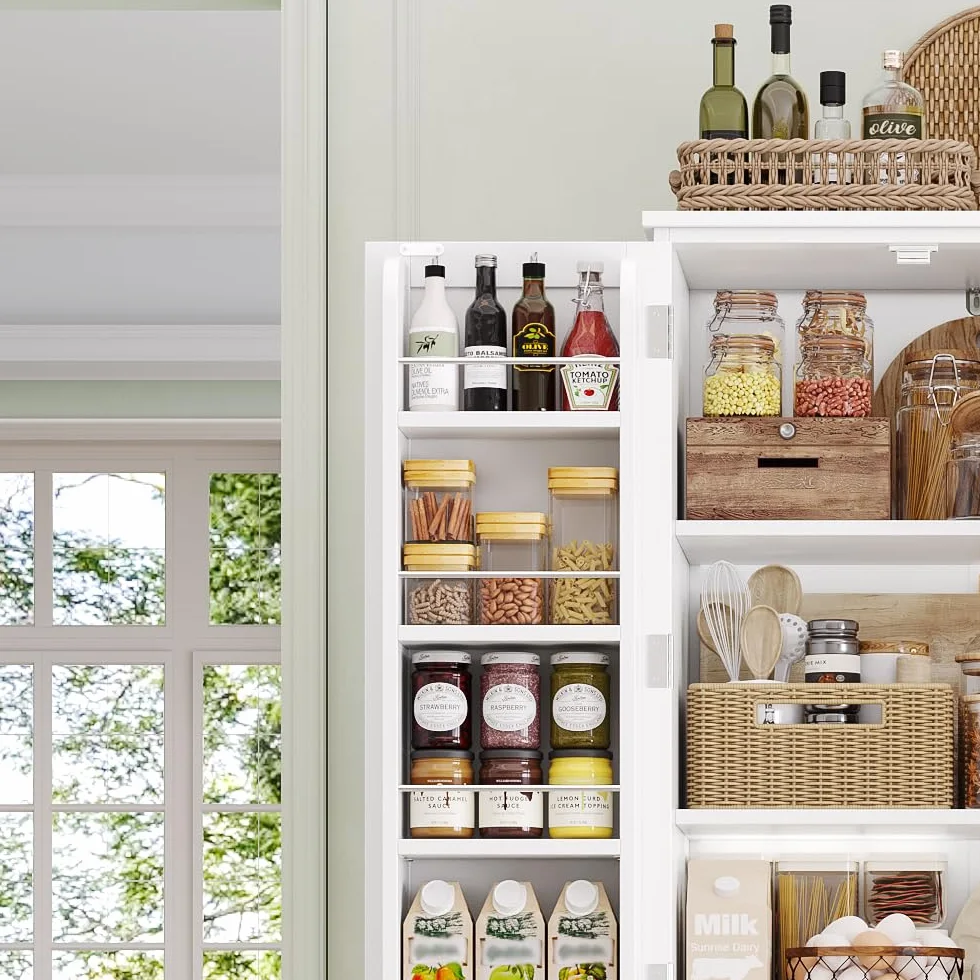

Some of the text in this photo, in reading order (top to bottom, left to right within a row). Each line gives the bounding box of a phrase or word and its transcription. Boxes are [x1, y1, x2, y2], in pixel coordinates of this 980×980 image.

[869, 120, 916, 135] olive
[694, 913, 759, 936] Milk
[732, 942, 759, 954] Dairy
